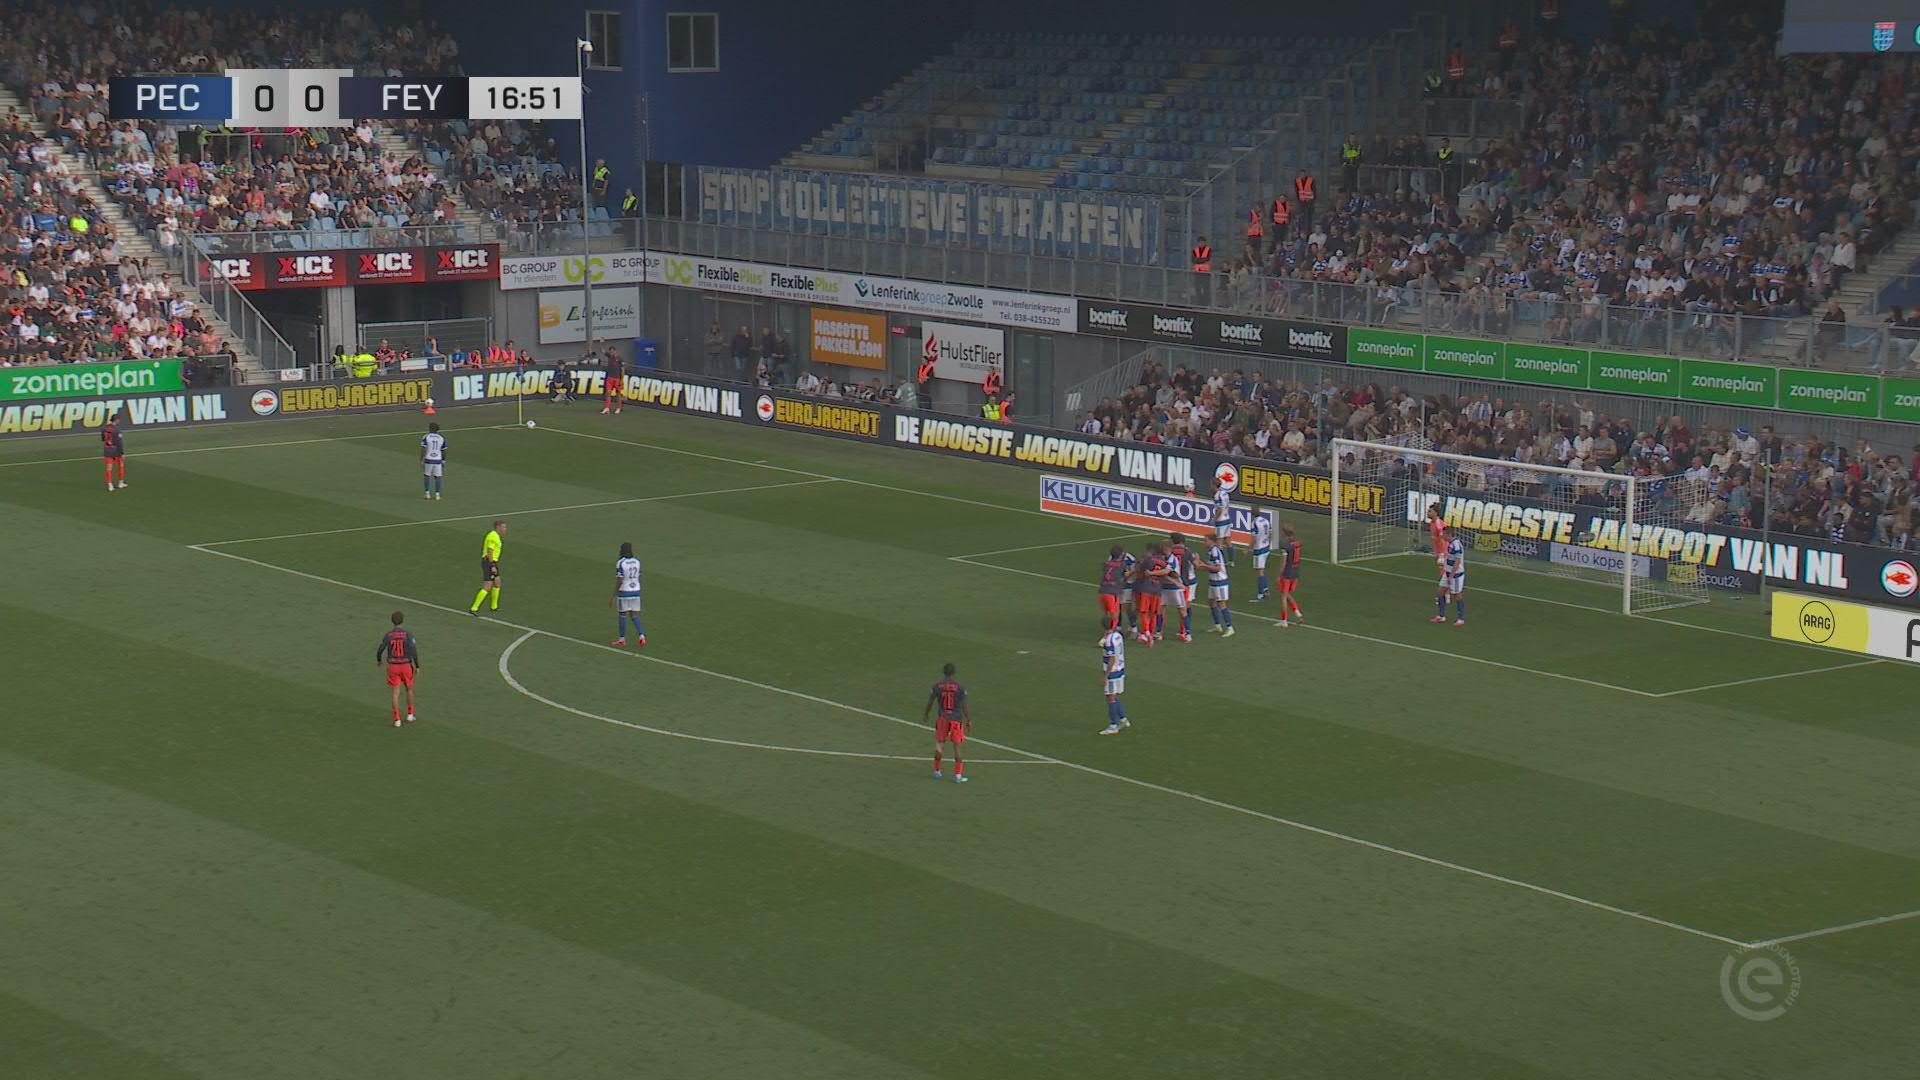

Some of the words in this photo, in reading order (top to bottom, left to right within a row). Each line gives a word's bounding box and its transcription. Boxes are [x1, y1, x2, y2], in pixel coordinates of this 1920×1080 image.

[503, 264, 517, 274] BC
[520, 261, 557, 273] GROUP
[613, 258, 627, 268] BC
[1089, 307, 1127, 326] bonfix
[1153, 314, 1192, 333] bonfix
[1221, 321, 1262, 341] bonfix
[1289, 328, 1332, 348] bonfix
[940, 340, 1002, 365] HulstFlier
[1357, 341, 1414, 359] zonneplan
[1434, 349, 1494, 366] zonneplan
[1514, 357, 1578, 375] zonneplan
[1601, 365, 1668, 384] zonneplan
[12, 364, 155, 395] zonneplan
[1691, 375, 1764, 393] zonneplan
[280, 379, 432, 414] EUROJACKPOT
[453, 374, 484, 400] DE
[685, 385, 718, 413] VAN
[721, 390, 742, 418] NL
[1790, 385, 1867, 403] zonneplan
[0, 399, 123, 433] ACKPOT
[126, 396, 186, 425] VAN
[192, 394, 227, 420] NL
[775, 397, 880, 438] EUROJACKPOT
[895, 415, 920, 443] DE
[921, 418, 1015, 457] HOOGSTE
[1015, 433, 1115, 474] JACKPOT
[1118, 447, 1163, 483] VAN
[1167, 454, 1195, 487] NL
[1444, 496, 1576, 543] HOOGSTE
[1729, 537, 1798, 581] VAN
[1805, 549, 1849, 589] NL
[1561, 548, 1590, 565] Auto
[1803, 613, 1831, 630] ARAG
